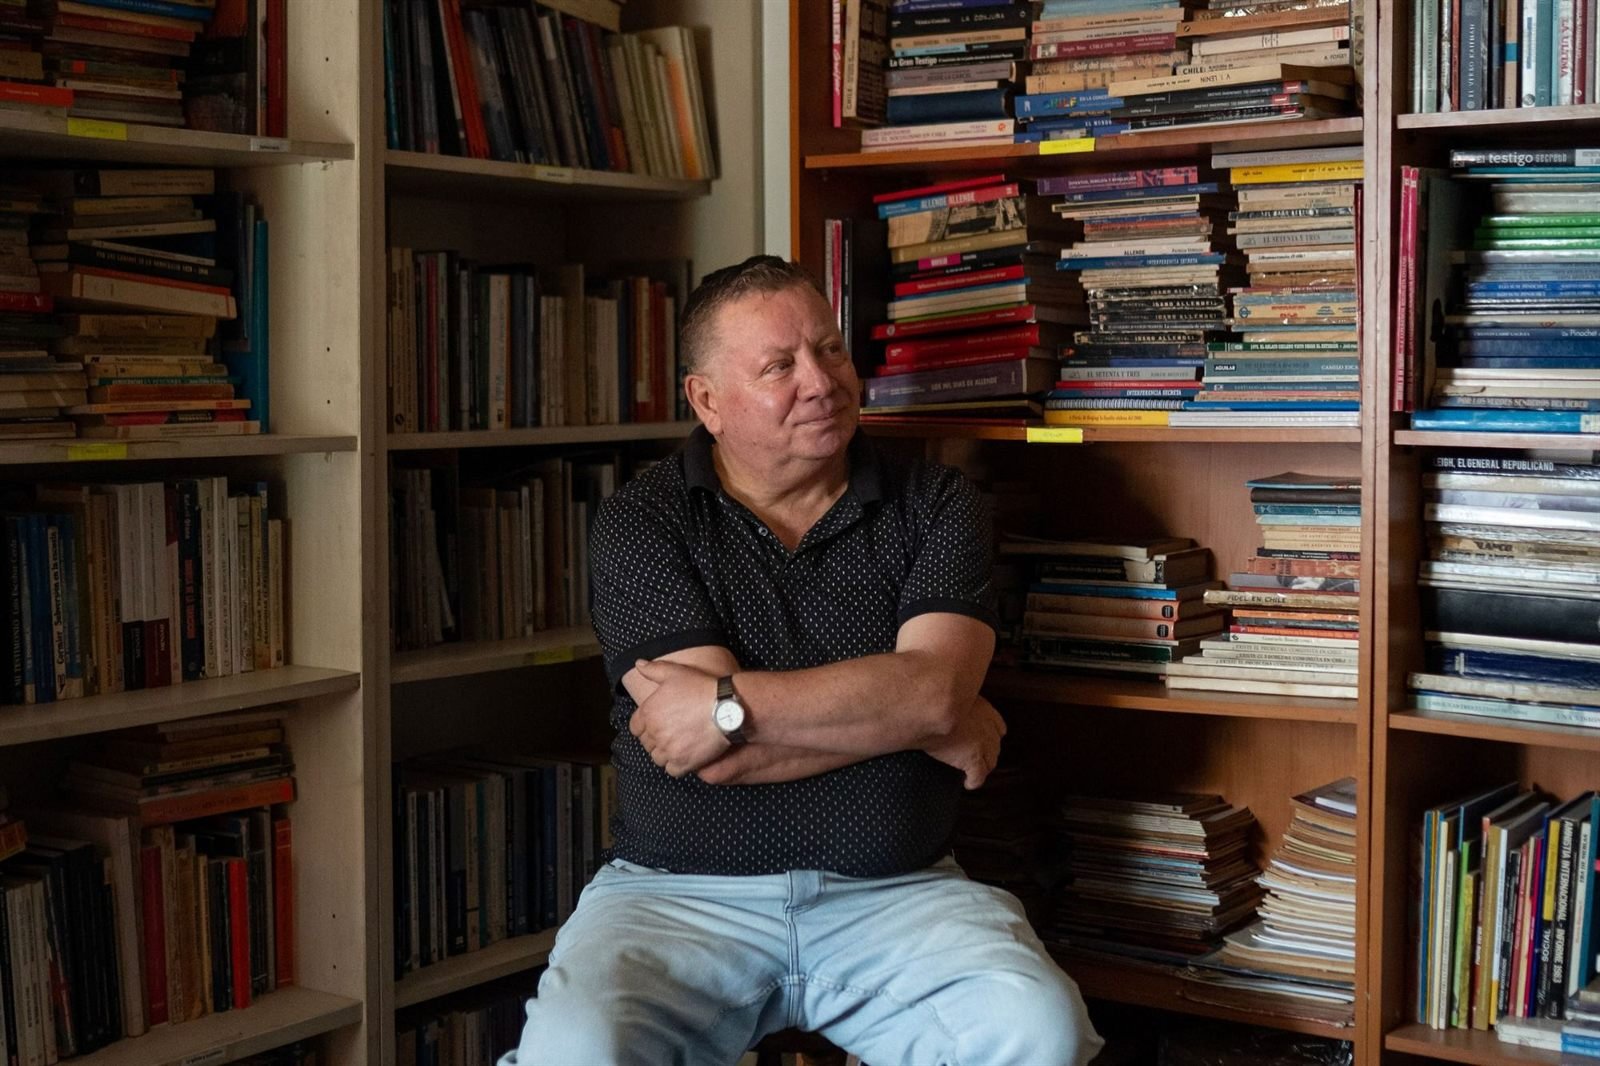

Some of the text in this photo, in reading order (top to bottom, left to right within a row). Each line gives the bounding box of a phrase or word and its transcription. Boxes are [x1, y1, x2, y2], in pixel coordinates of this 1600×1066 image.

[1488, 152, 1534, 166] testigo
[920, 197, 947, 209] ALLENDE
[948, 192, 976, 204] ALLENDE
[1569, 329, 1597, 337] Pinochet
[975, 376, 998, 386] ALLENDE
[1095, 370, 1120, 378] SETENTA
[1457, 458, 1466, 468] EL
[1466, 458, 1500, 469] GENERAL
[1502, 460, 1554, 471] REPUBLICANO
[1227, 594, 1249, 602] FIDEL
[13, 618, 21, 673] TESTIMONIO
[1561, 820, 1573, 859] AMNISTIA
[1557, 859, 1572, 921] INTERNACIONAL
[1541, 929, 1551, 963] SOCIAL
[1555, 928, 1566, 965] INFORME
